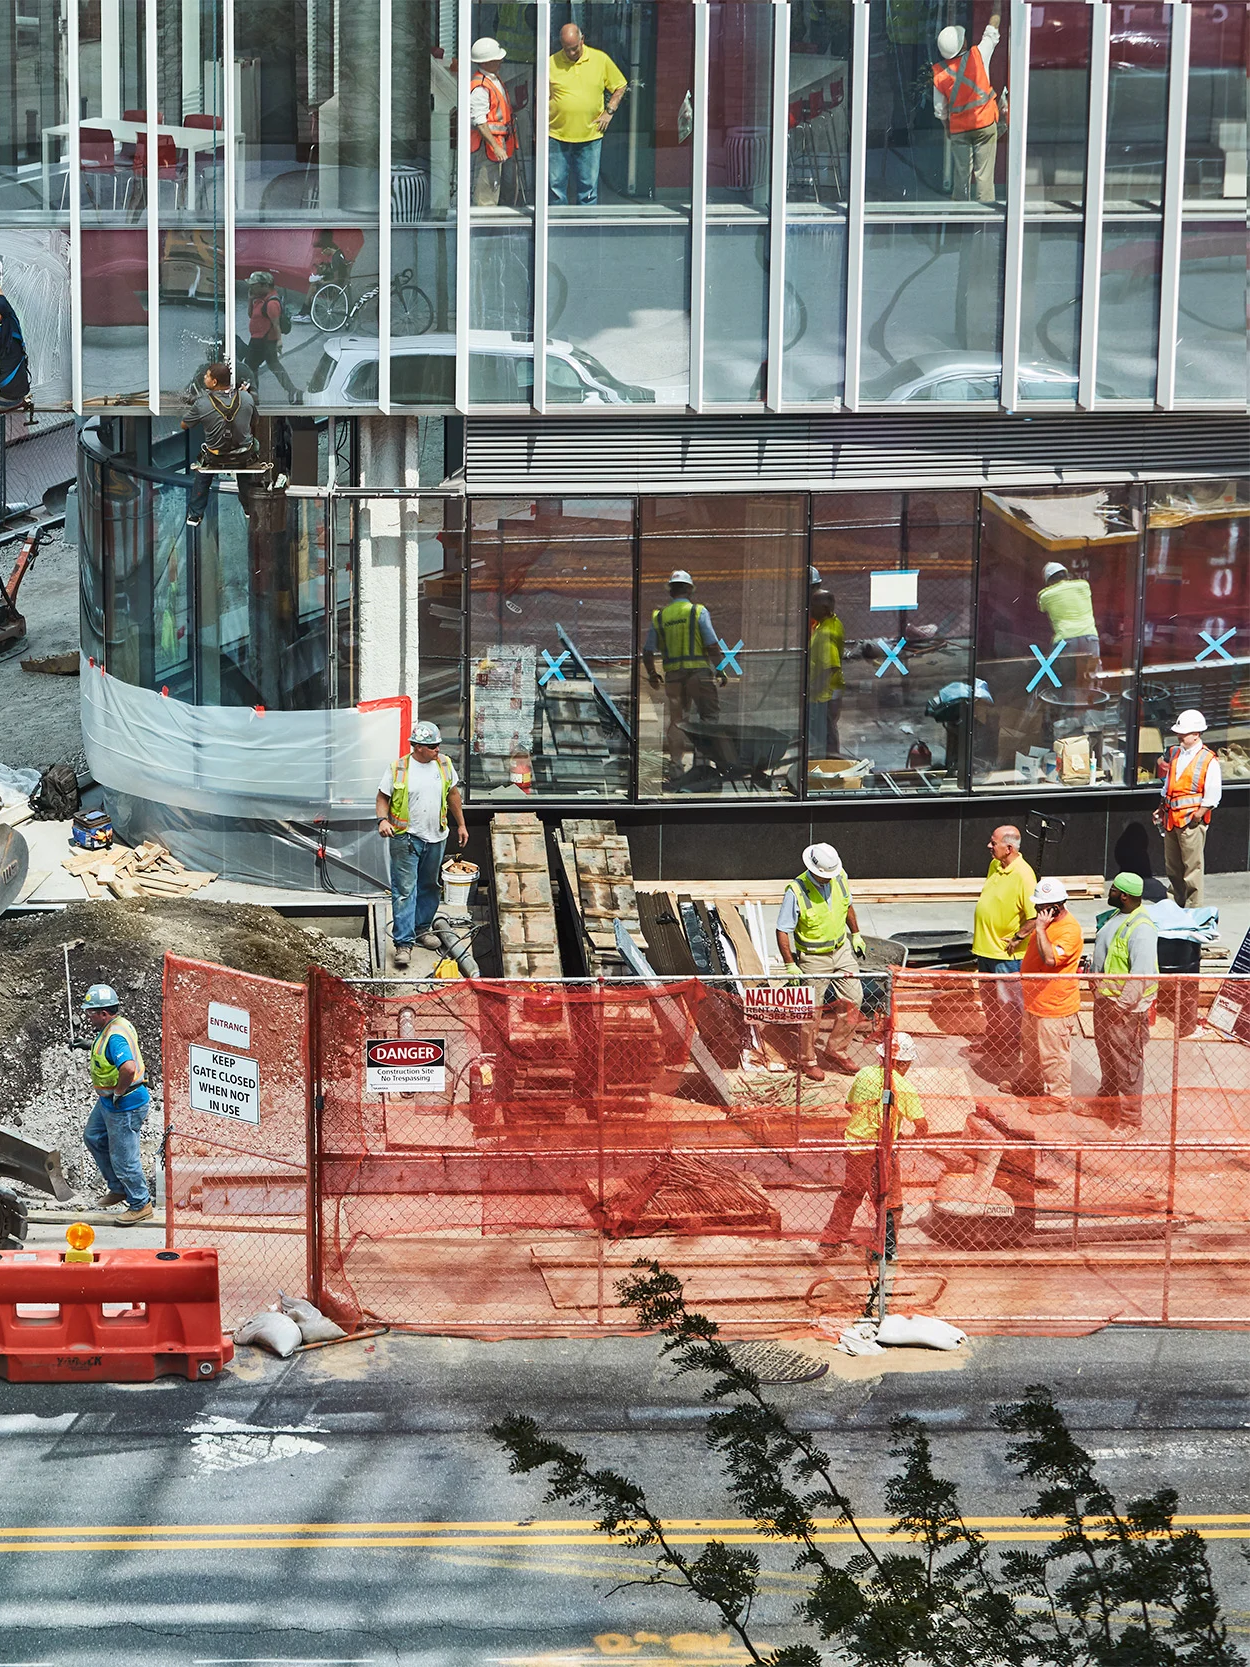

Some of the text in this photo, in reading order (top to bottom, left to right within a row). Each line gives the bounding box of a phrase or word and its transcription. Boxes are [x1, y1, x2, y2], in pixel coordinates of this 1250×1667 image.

[746, 988, 812, 1006] NATIONAL
[209, 1016, 248, 1035] ENTRANCE
[212, 1053, 236, 1069] KEEP
[376, 1046, 435, 1060] DANGER
[192, 1064, 256, 1090] GATE CLOSED
[377, 1067, 435, 1076] Construction Site
[392, 1074, 431, 1083] Trespassing
[198, 1081, 250, 1104] WHEN NOT
[209, 1099, 240, 1117] IN USE
